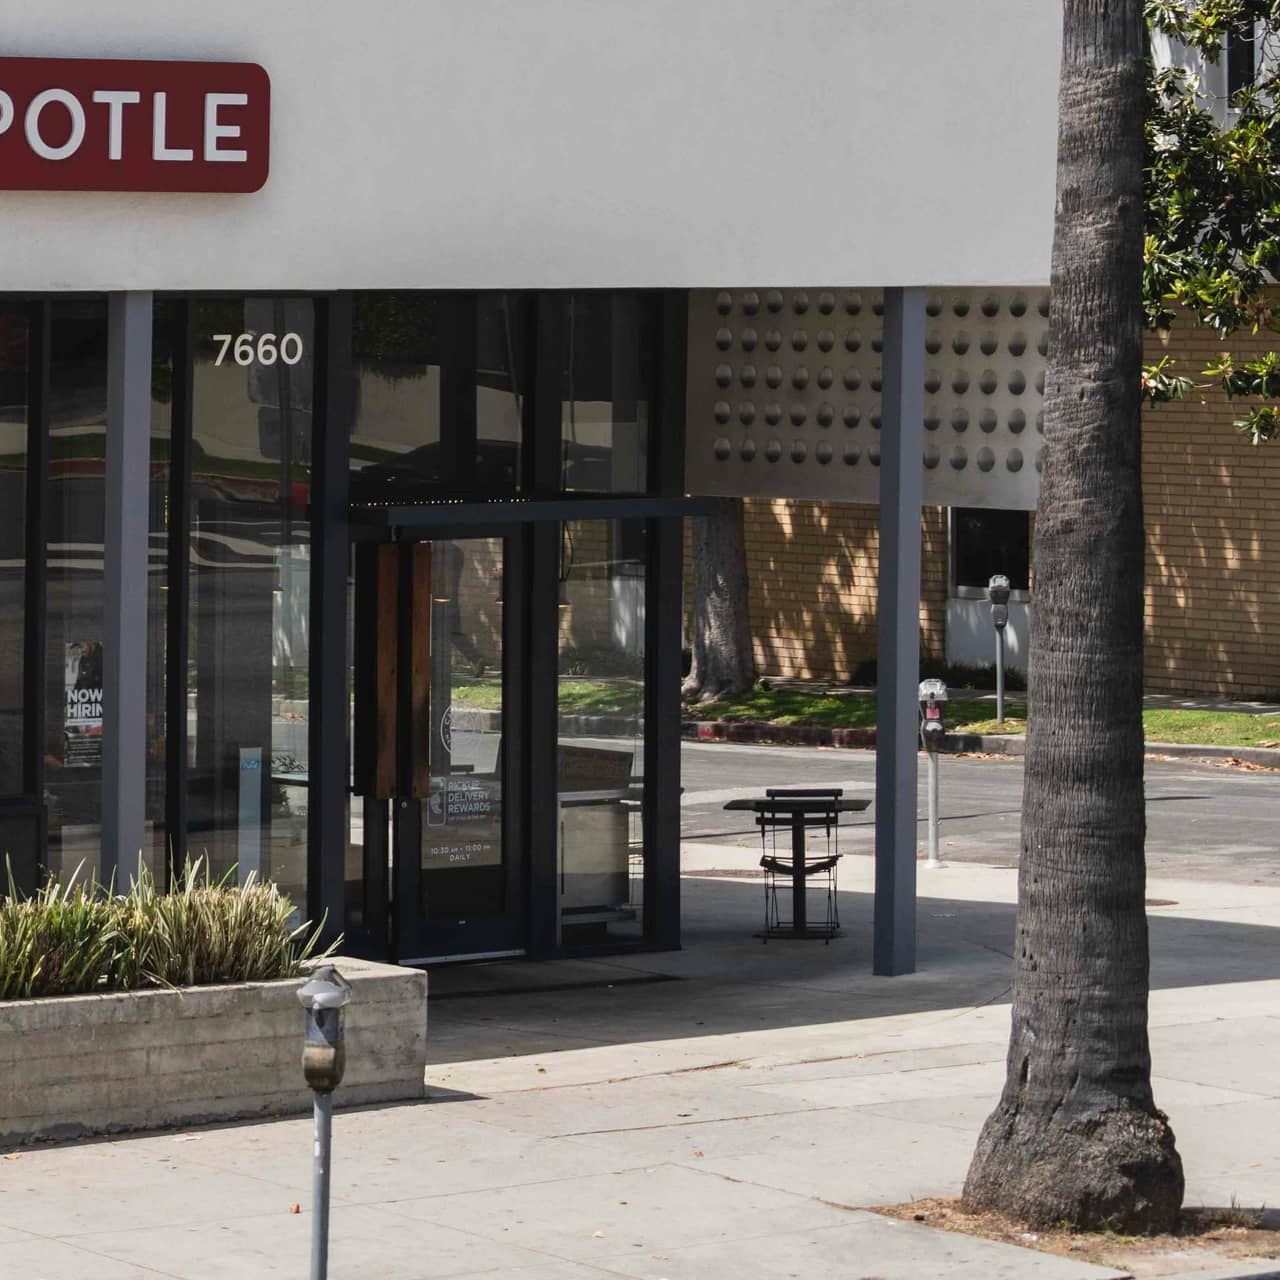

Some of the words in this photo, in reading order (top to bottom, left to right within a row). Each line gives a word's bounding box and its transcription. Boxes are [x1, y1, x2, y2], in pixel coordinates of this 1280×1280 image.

[212, 332, 303, 366] 7660
[67, 688, 103, 702] NOW
[67, 703, 103, 718] HIRIN
[448, 791, 489, 802] DELIVERY
[448, 802, 491, 814] REWARDS
[450, 854, 471, 862] DAILY
